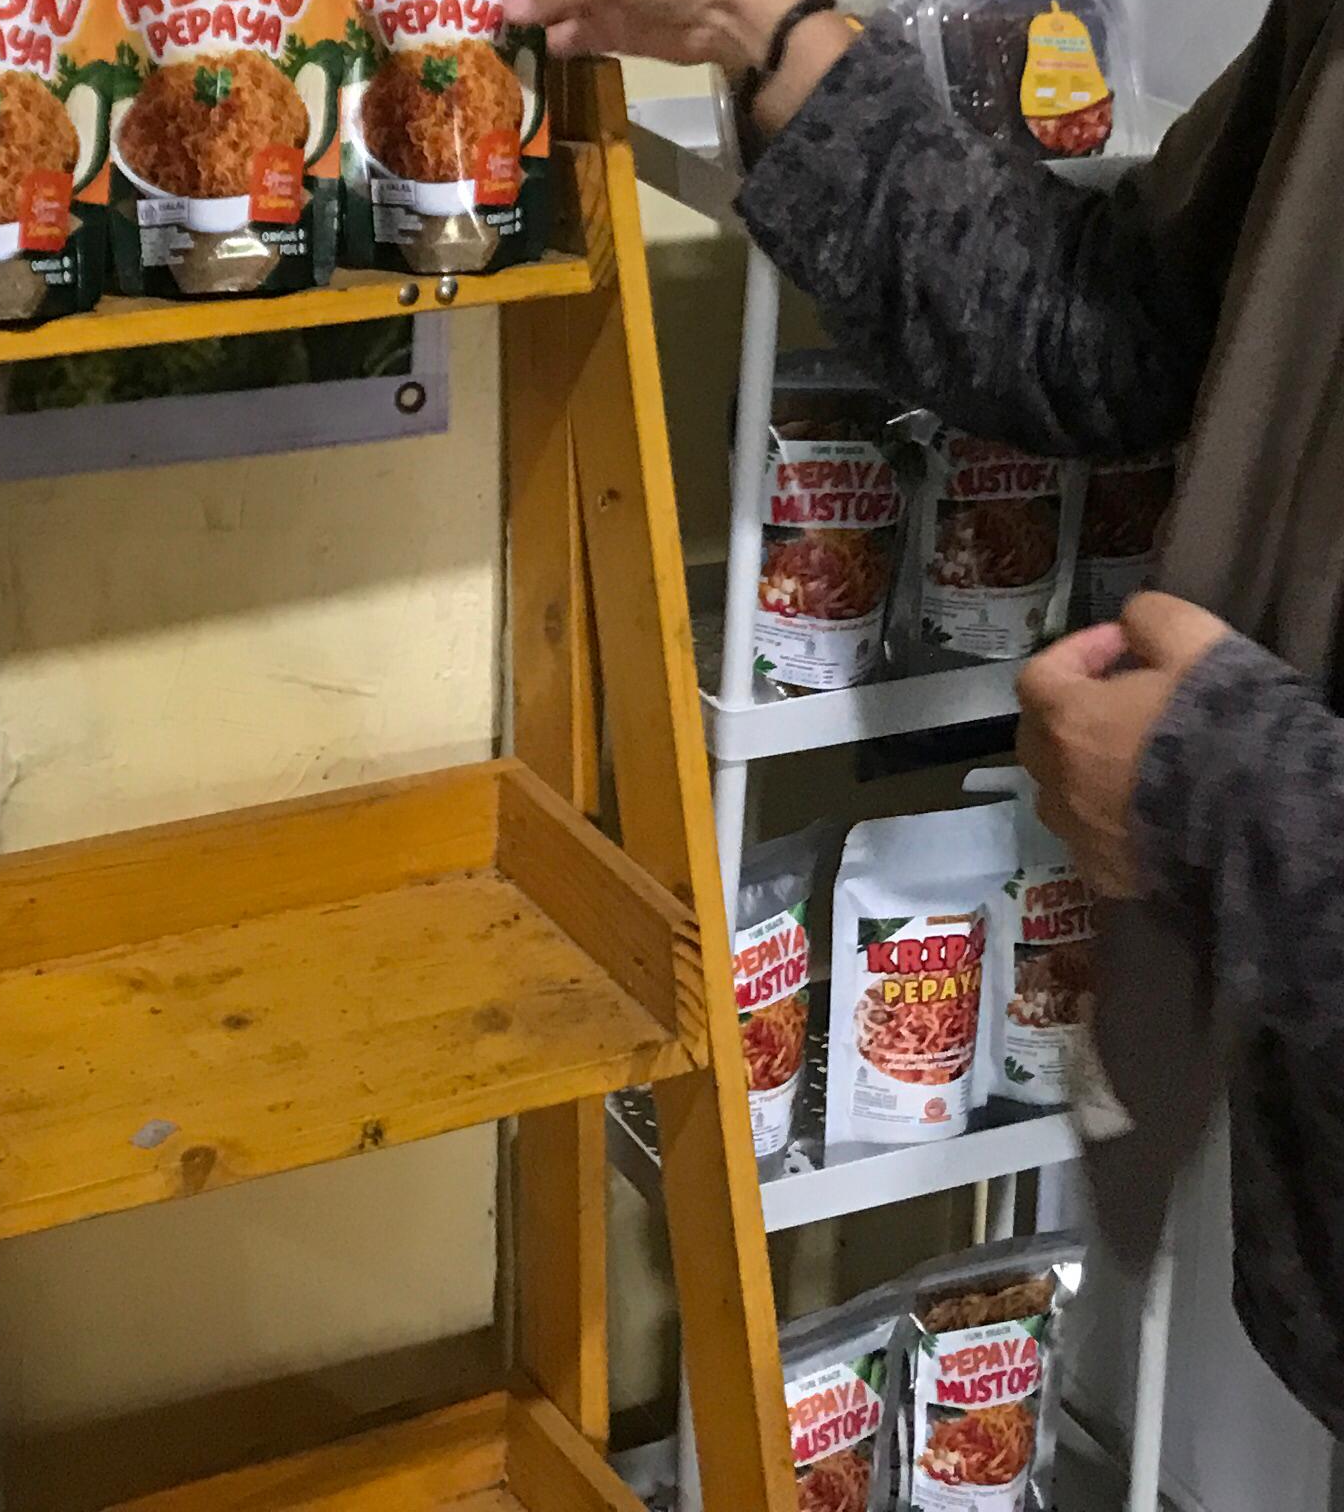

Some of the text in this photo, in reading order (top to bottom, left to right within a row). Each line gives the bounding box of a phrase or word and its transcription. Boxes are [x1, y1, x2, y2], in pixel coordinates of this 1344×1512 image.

[147, 4, 282, 58] PEPAYA
[947, 462, 1056, 496] MUSTOF
[736, 953, 807, 1008] MUSTOF
[939, 1336, 1038, 1377] PEPAYA
